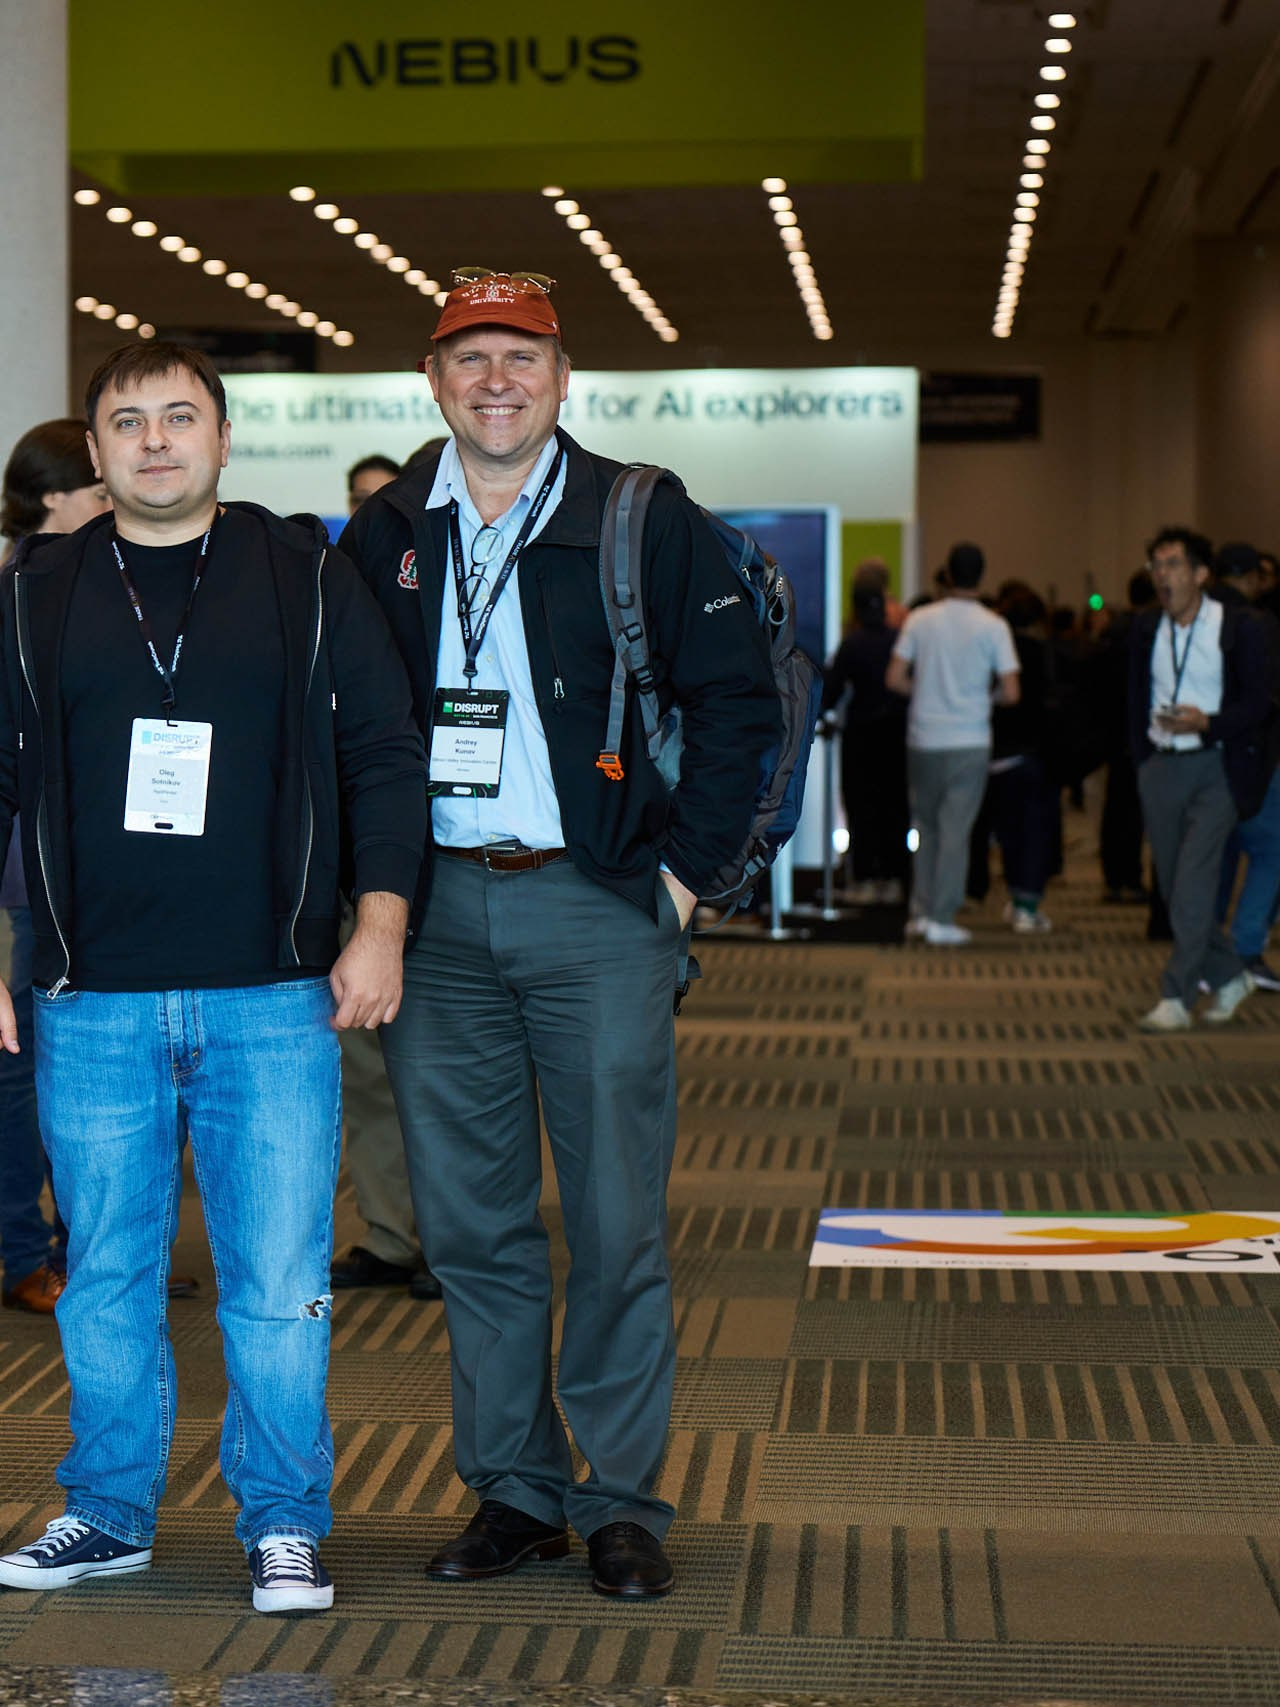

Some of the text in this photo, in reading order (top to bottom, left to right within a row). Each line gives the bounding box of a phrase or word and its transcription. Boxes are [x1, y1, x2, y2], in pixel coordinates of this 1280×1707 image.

[330, 35, 642, 87] NEBIUS
[469, 297, 515, 305] UNIVERSITY
[586, 388, 641, 419] for
[655, 386, 694, 419] AI
[704, 385, 904, 424] explorers
[454, 702, 499, 714] DISRUPT
